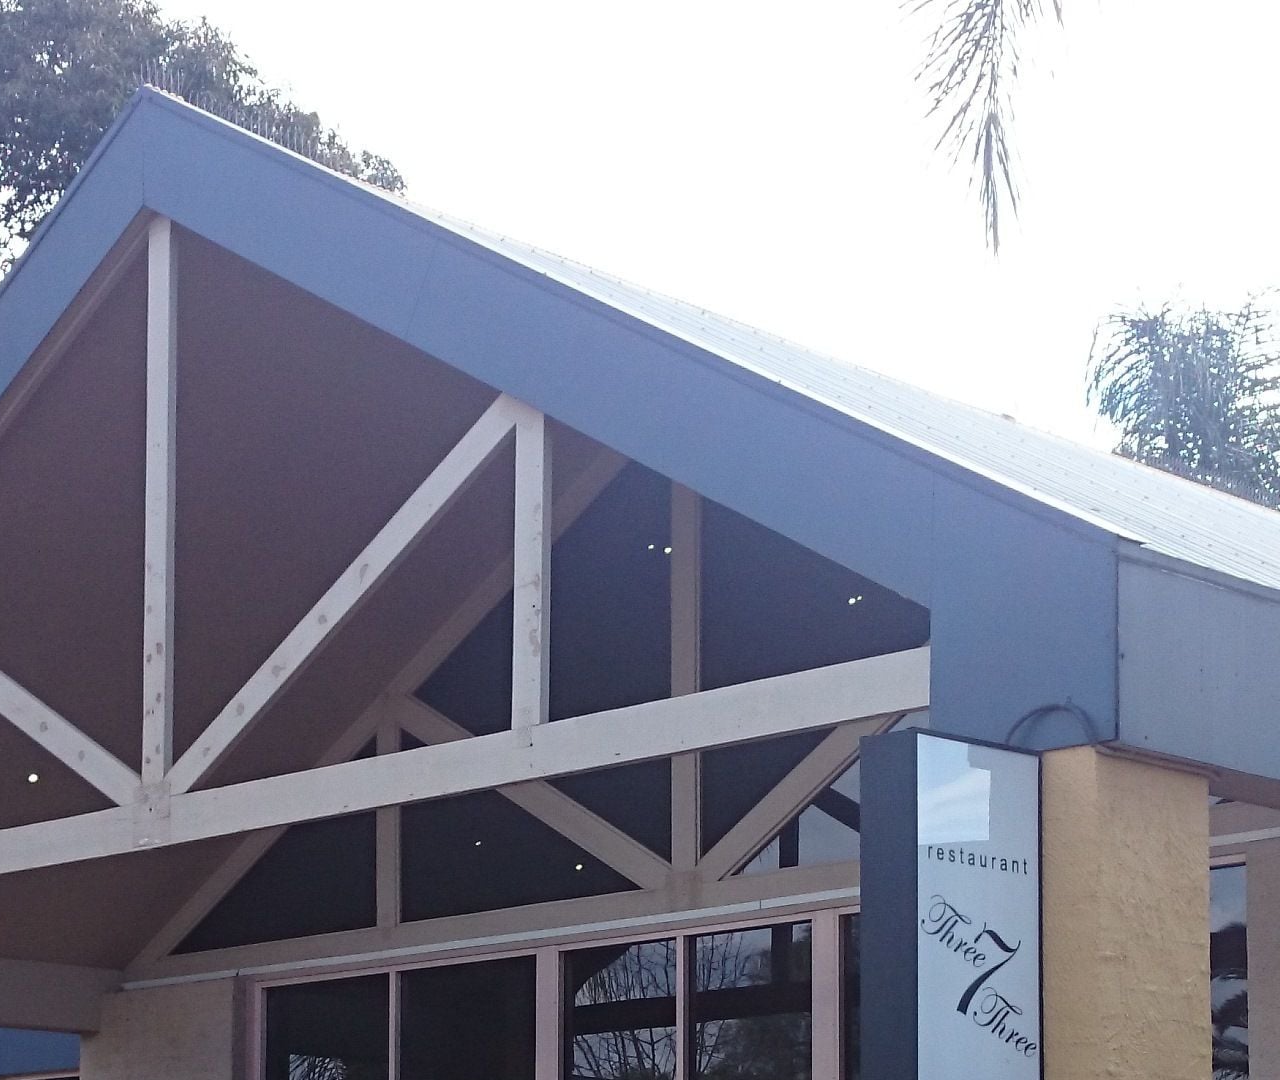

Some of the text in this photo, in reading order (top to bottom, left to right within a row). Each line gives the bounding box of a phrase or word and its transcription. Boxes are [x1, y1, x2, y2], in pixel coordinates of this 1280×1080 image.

[927, 845, 1028, 876] restaurant
[920, 894, 1038, 1059] Three 7 Three
